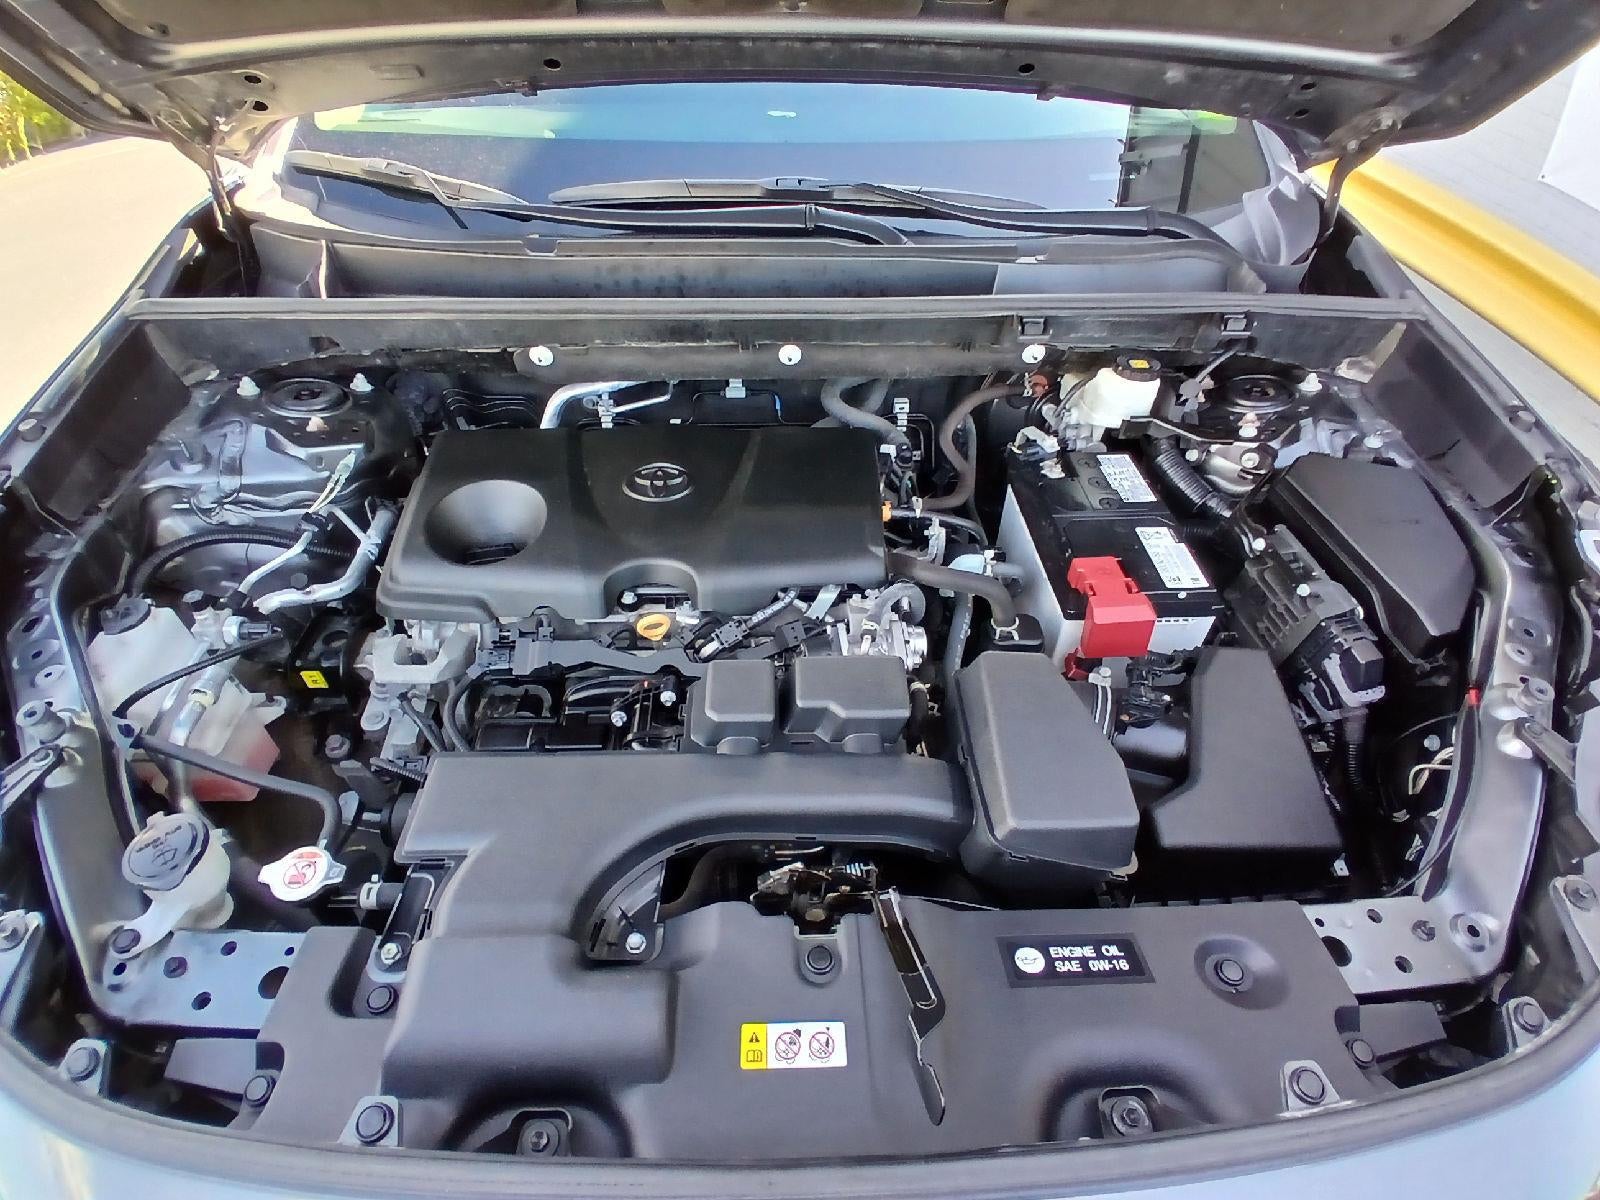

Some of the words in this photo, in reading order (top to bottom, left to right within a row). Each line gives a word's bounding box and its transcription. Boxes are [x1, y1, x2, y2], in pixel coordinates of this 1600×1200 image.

[1049, 946, 1096, 958] ENGINE
[1101, 945, 1124, 957] OIL
[1054, 960, 1083, 971] SAE
[1088, 959, 1130, 971] 0W-16
